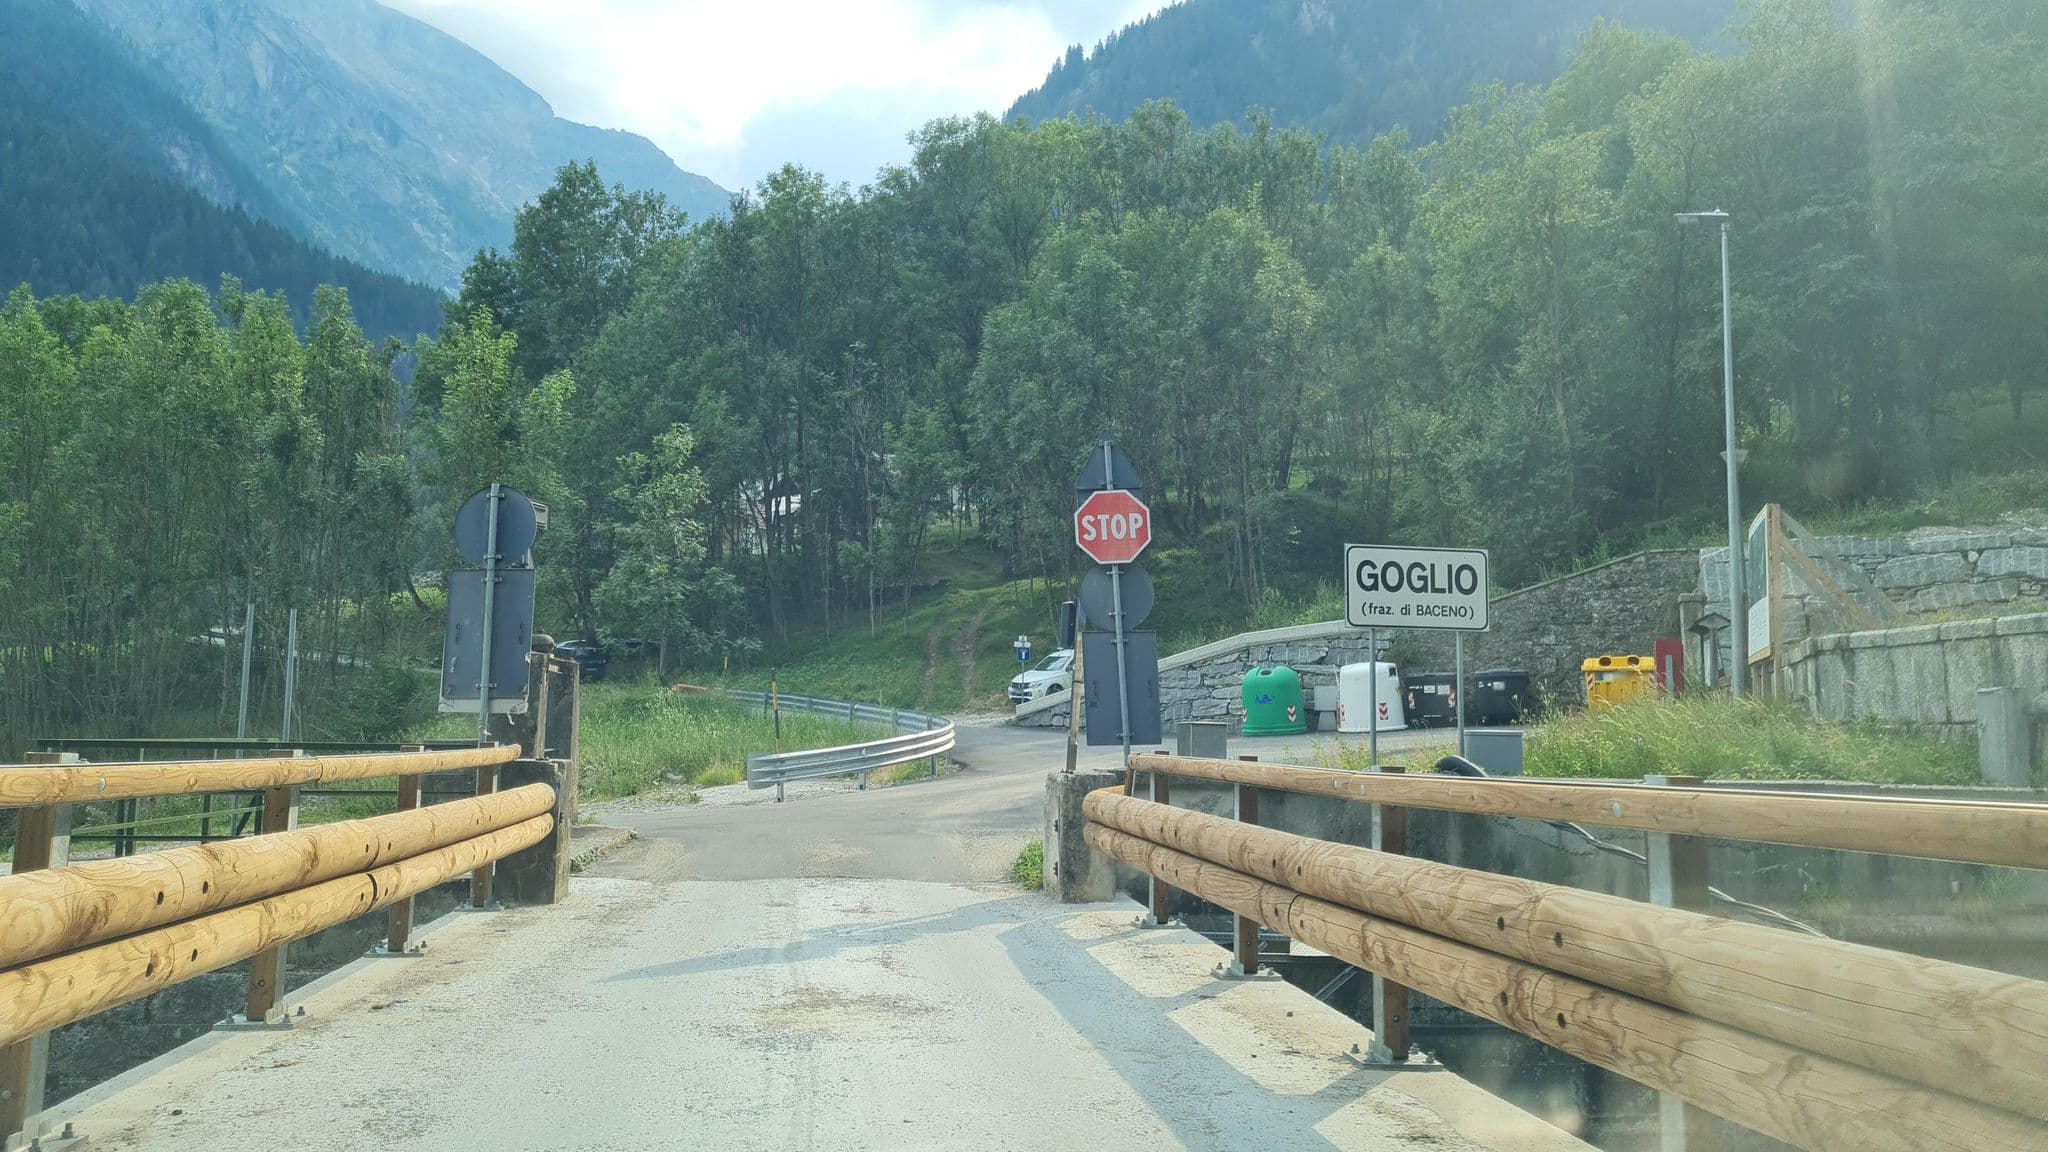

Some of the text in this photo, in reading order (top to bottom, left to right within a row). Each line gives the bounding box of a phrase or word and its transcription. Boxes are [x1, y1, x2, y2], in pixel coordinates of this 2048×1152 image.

[1081, 513, 1143, 541] STOP
[1356, 559, 1478, 595] GOGLIO
[1361, 601, 1474, 620] (fraz. di BACENO)
